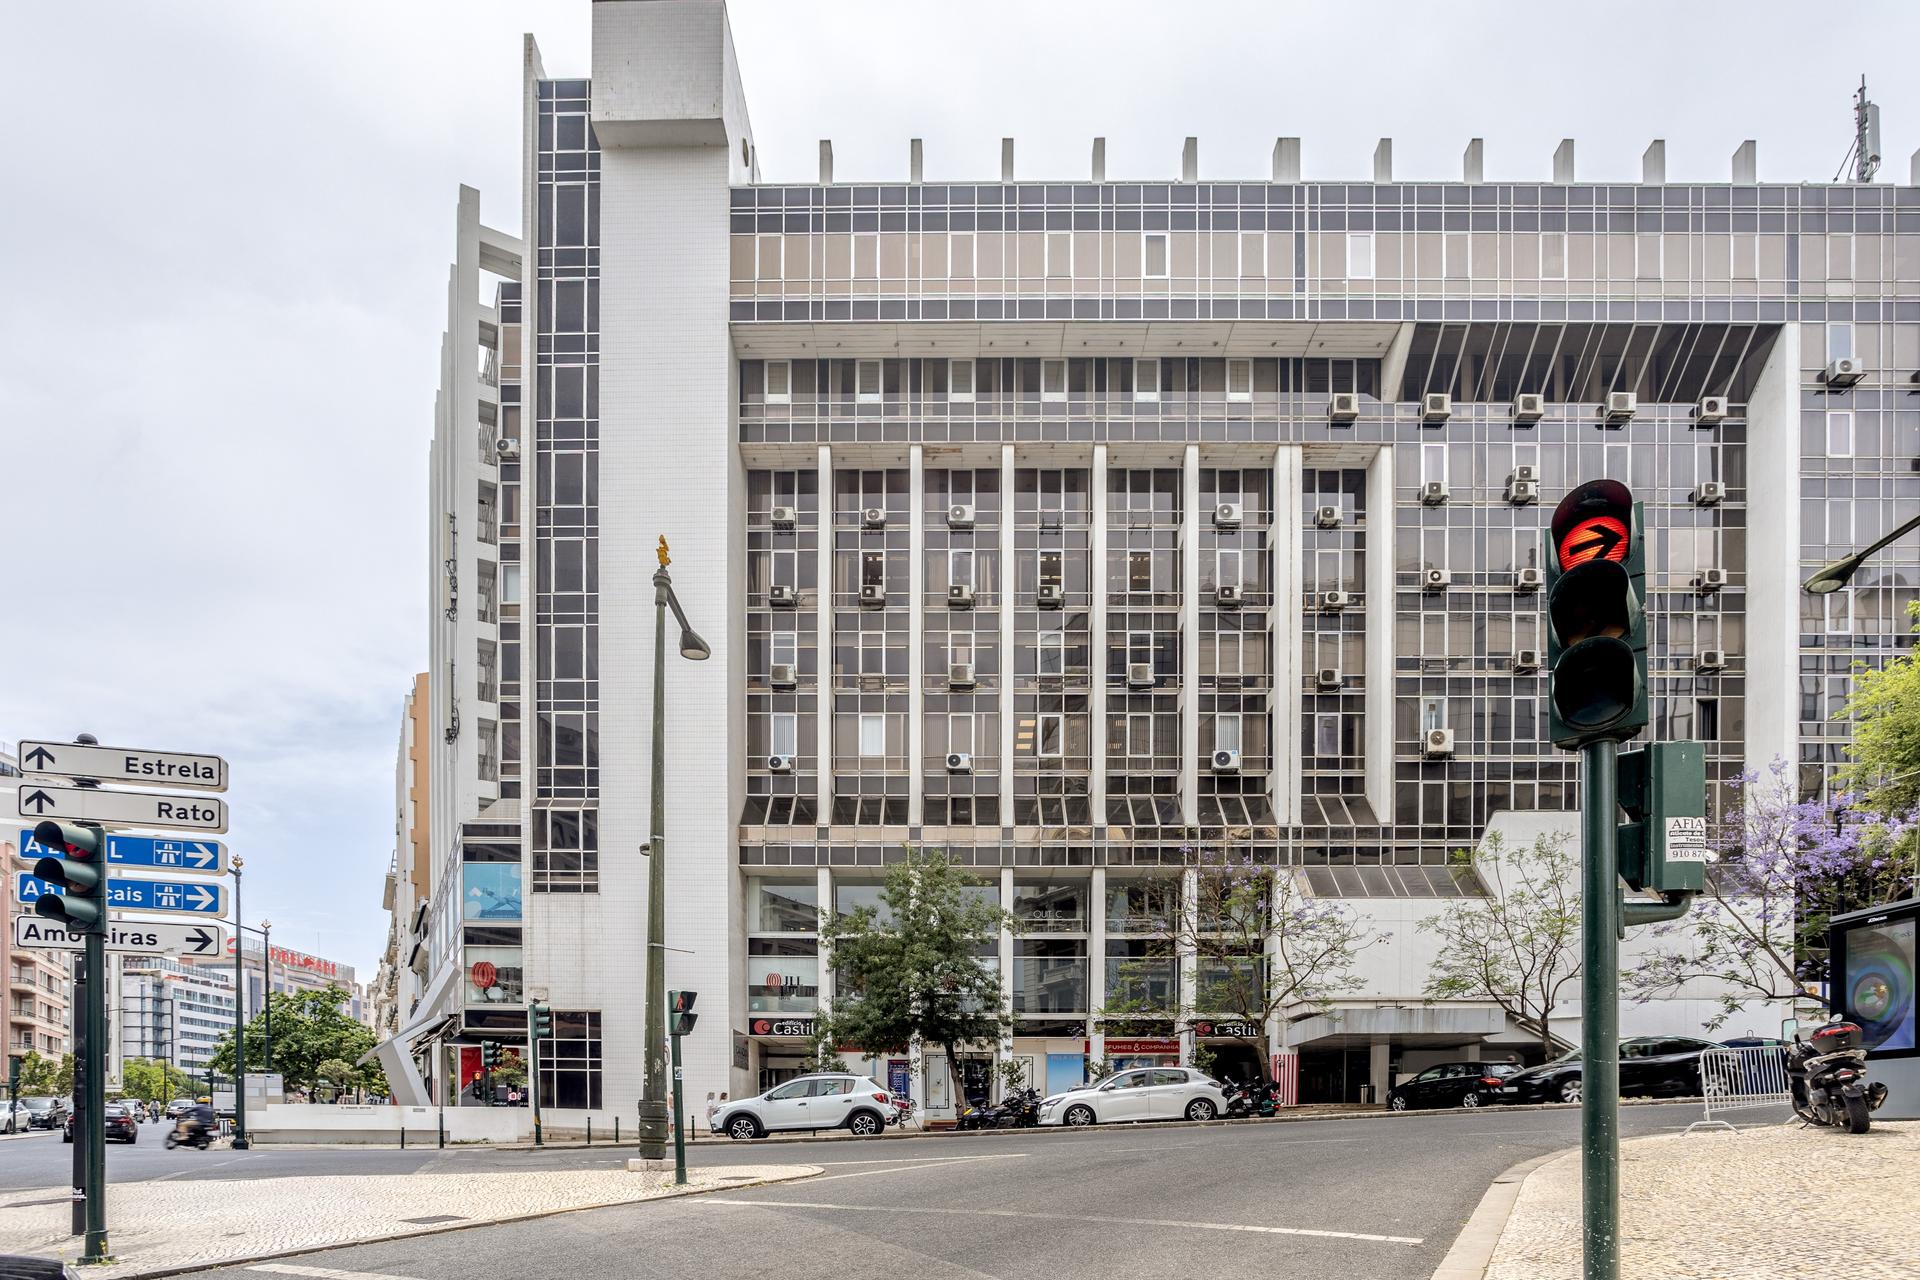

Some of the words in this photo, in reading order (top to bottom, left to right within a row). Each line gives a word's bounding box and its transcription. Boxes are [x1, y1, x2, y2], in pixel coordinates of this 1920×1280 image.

[125, 756, 214, 780] Estrela
[157, 801, 215, 822] Rato
[1672, 850, 1690, 858] 910
[23, 923, 158, 946] Amoiras
[773, 1022, 815, 1035] Castil
